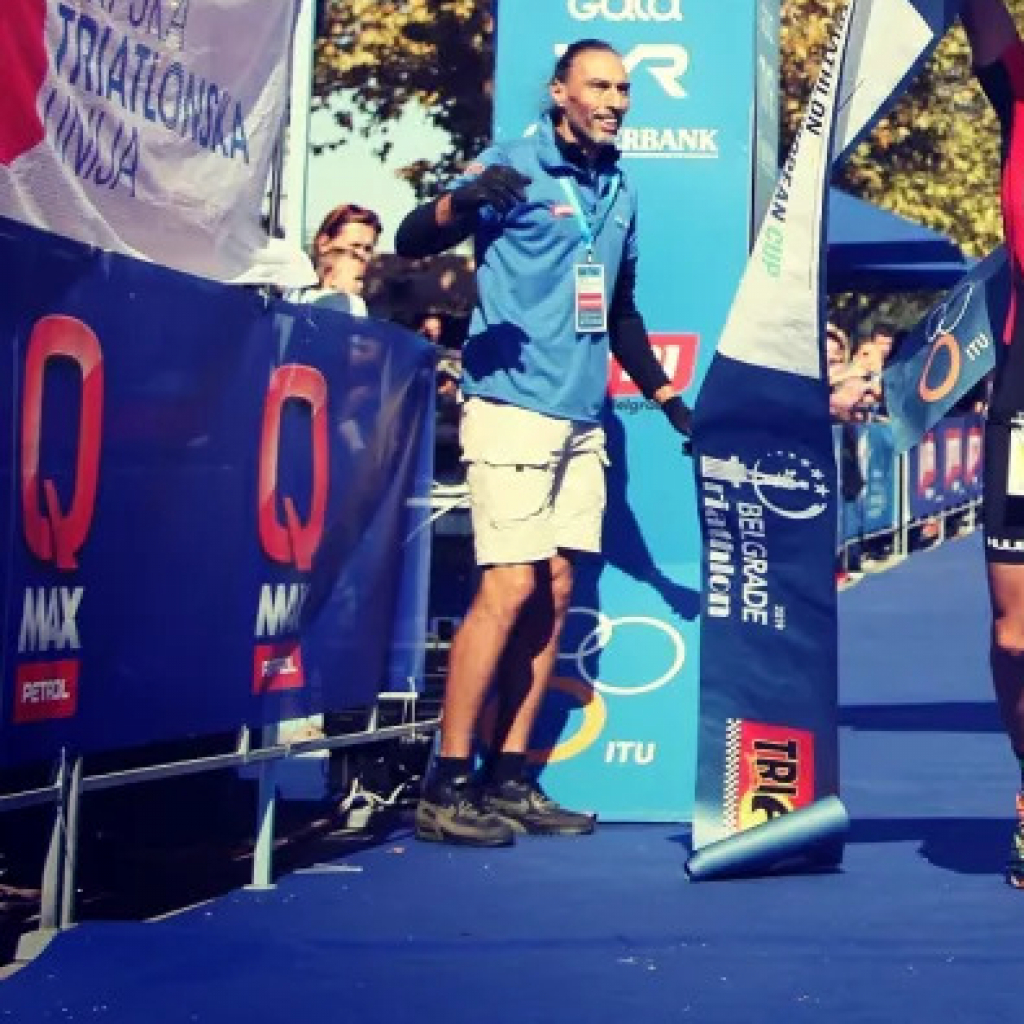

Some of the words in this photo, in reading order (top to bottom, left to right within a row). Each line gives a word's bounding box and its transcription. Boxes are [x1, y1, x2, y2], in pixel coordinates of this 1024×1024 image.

[54, 2, 250, 164] TRIATLONSKA
[19, 313, 105, 571] Q
[255, 363, 331, 572] Q
[17, 586, 85, 654] MAX
[737, 502, 769, 625] BELGRADE
[21, 678, 72, 704] PETROL
[603, 740, 657, 765] ITU
